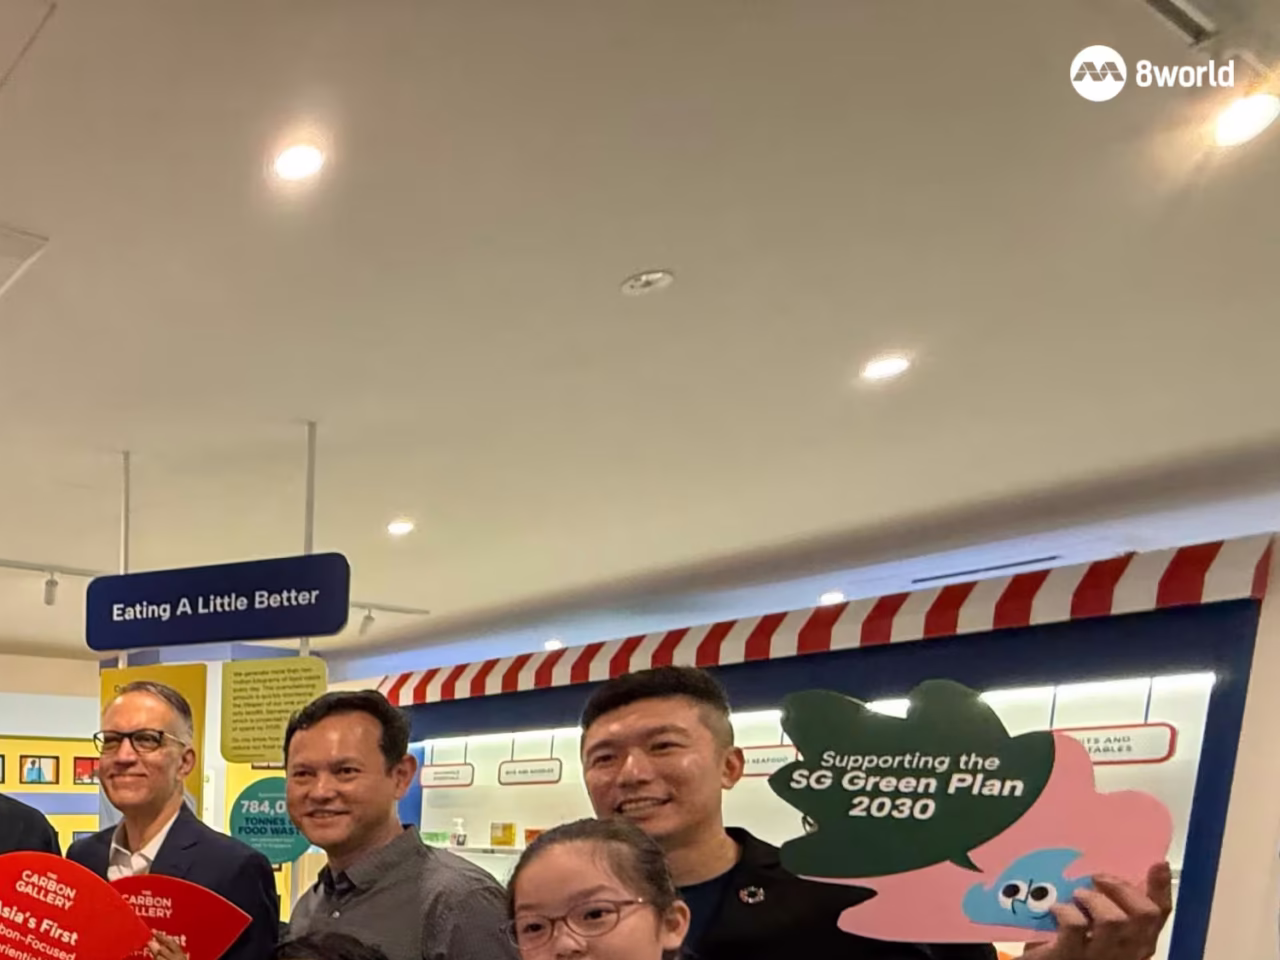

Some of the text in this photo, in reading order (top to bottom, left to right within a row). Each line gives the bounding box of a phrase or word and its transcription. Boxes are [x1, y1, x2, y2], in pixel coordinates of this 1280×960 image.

[113, 588, 320, 621] Eating A Little Better
[821, 750, 1001, 773] Supporting the
[790, 769, 1025, 797] SG Green Plan
[848, 796, 937, 820] 2030
[238, 826, 301, 836] FOOD WAST
[244, 817, 286, 826] TONNES
[15, 880, 75, 910] GALLERY
[22, 870, 77, 899] CARBON
[121, 894, 172, 908] CARBON
[130, 906, 173, 918] LLERY
[39, 918, 79, 946] First
